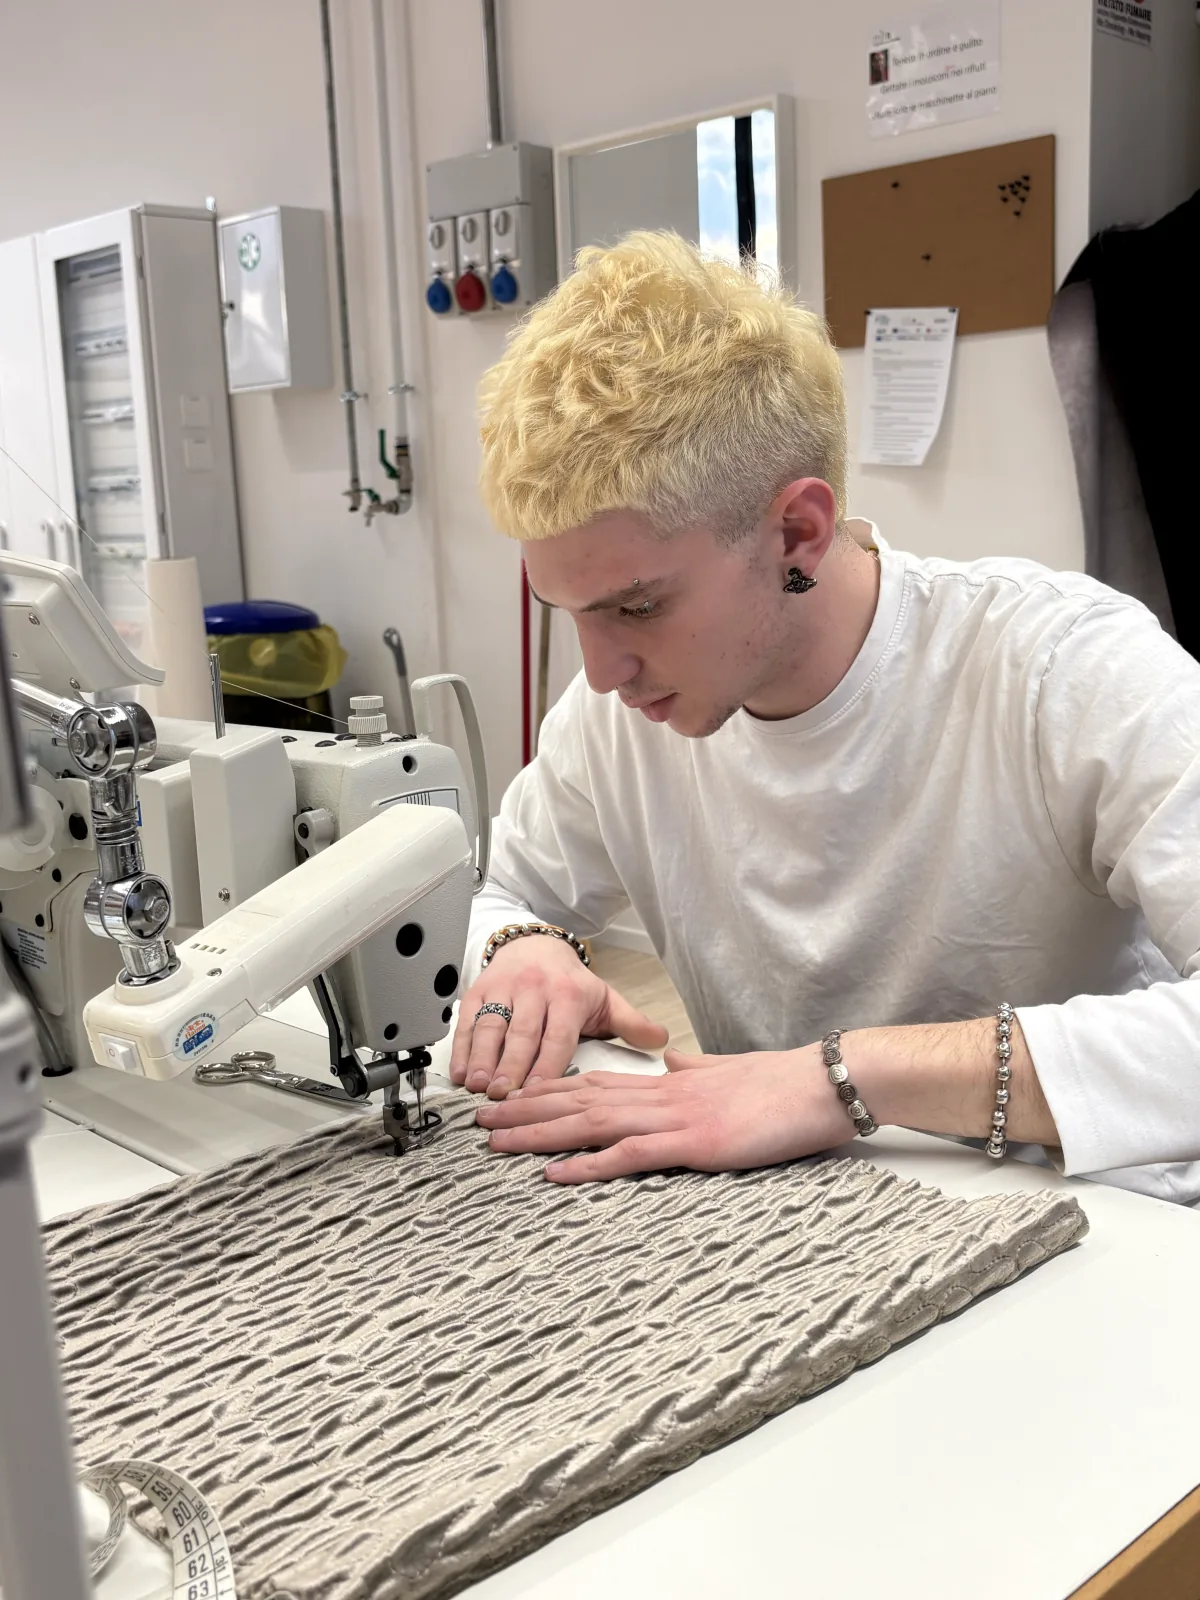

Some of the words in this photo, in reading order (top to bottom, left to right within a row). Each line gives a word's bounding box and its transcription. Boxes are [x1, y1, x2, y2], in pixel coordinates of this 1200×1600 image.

[151, 1480, 173, 1502] 59
[172, 1501, 192, 1528] 60
[182, 1527, 200, 1554] 61
[188, 1553, 209, 1579] 62
[188, 1580, 209, 1600] 63
